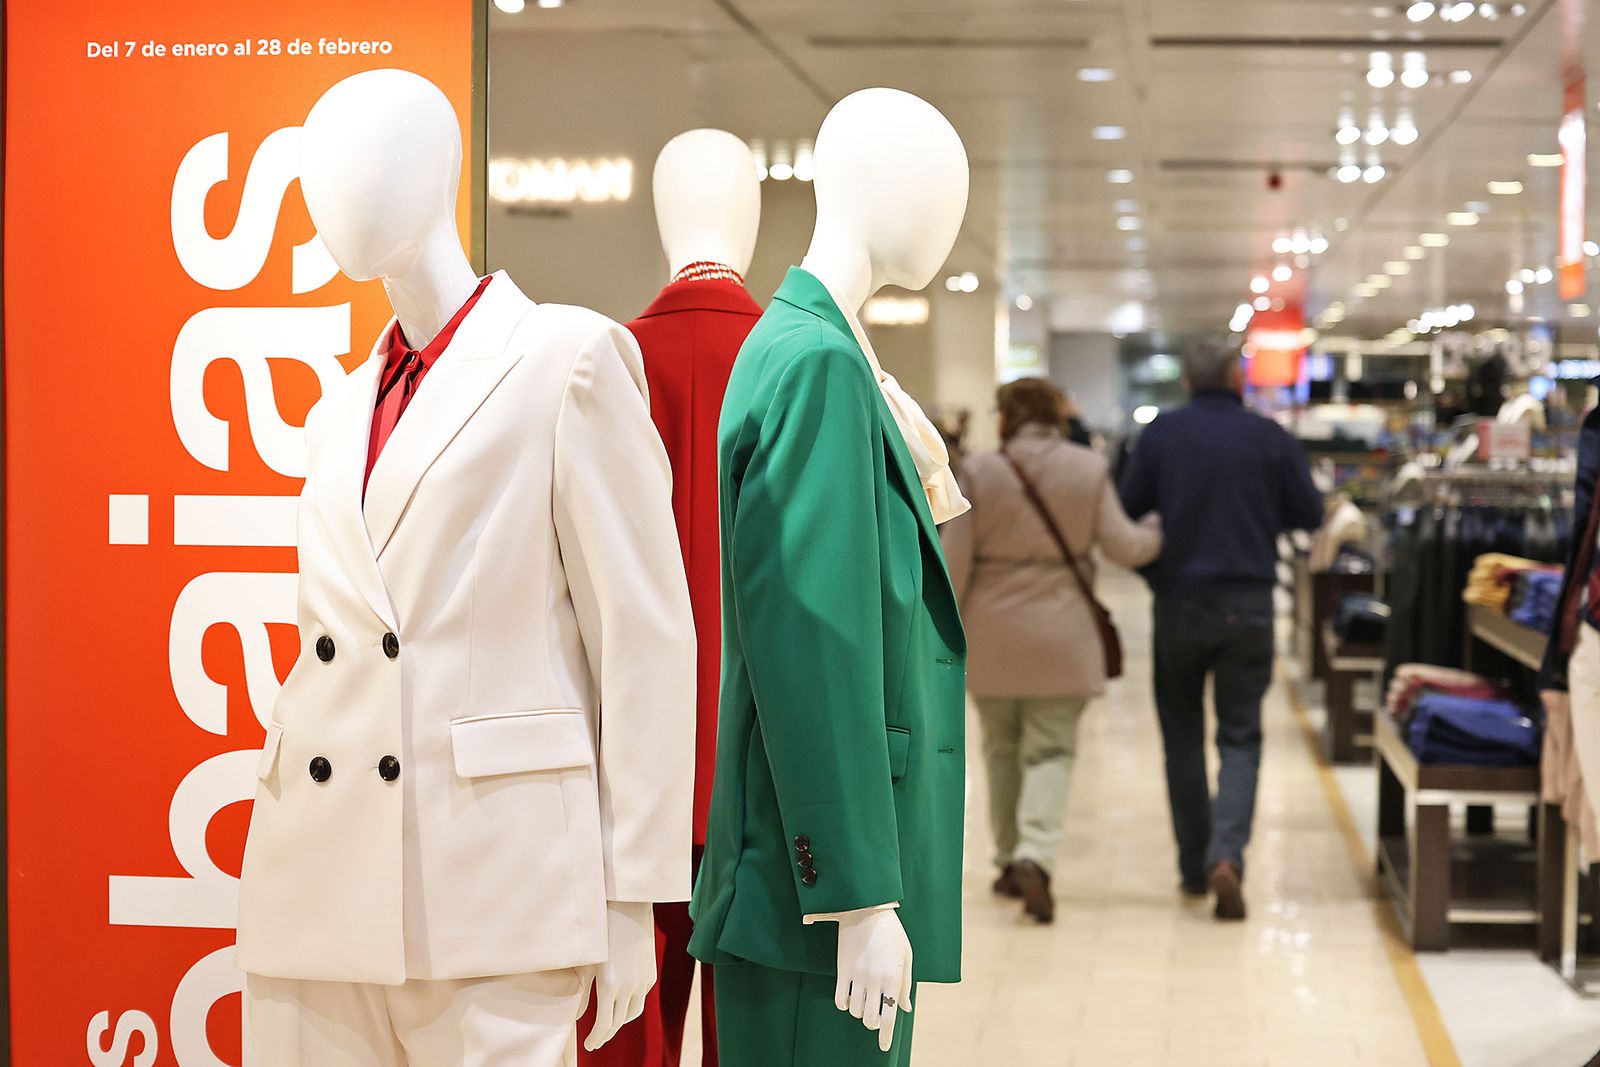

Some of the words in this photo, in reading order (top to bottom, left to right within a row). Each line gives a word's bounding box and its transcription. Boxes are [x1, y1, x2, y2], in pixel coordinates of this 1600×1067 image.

[87, 41, 119, 57] Del
[125, 41, 136, 57] 7
[141, 40, 167, 57] de
[171, 43, 229, 56] enero
[233, 39, 251, 56] al
[257, 39, 281, 55] 28
[287, 38, 312, 55] de
[318, 37, 393, 54] febrero
